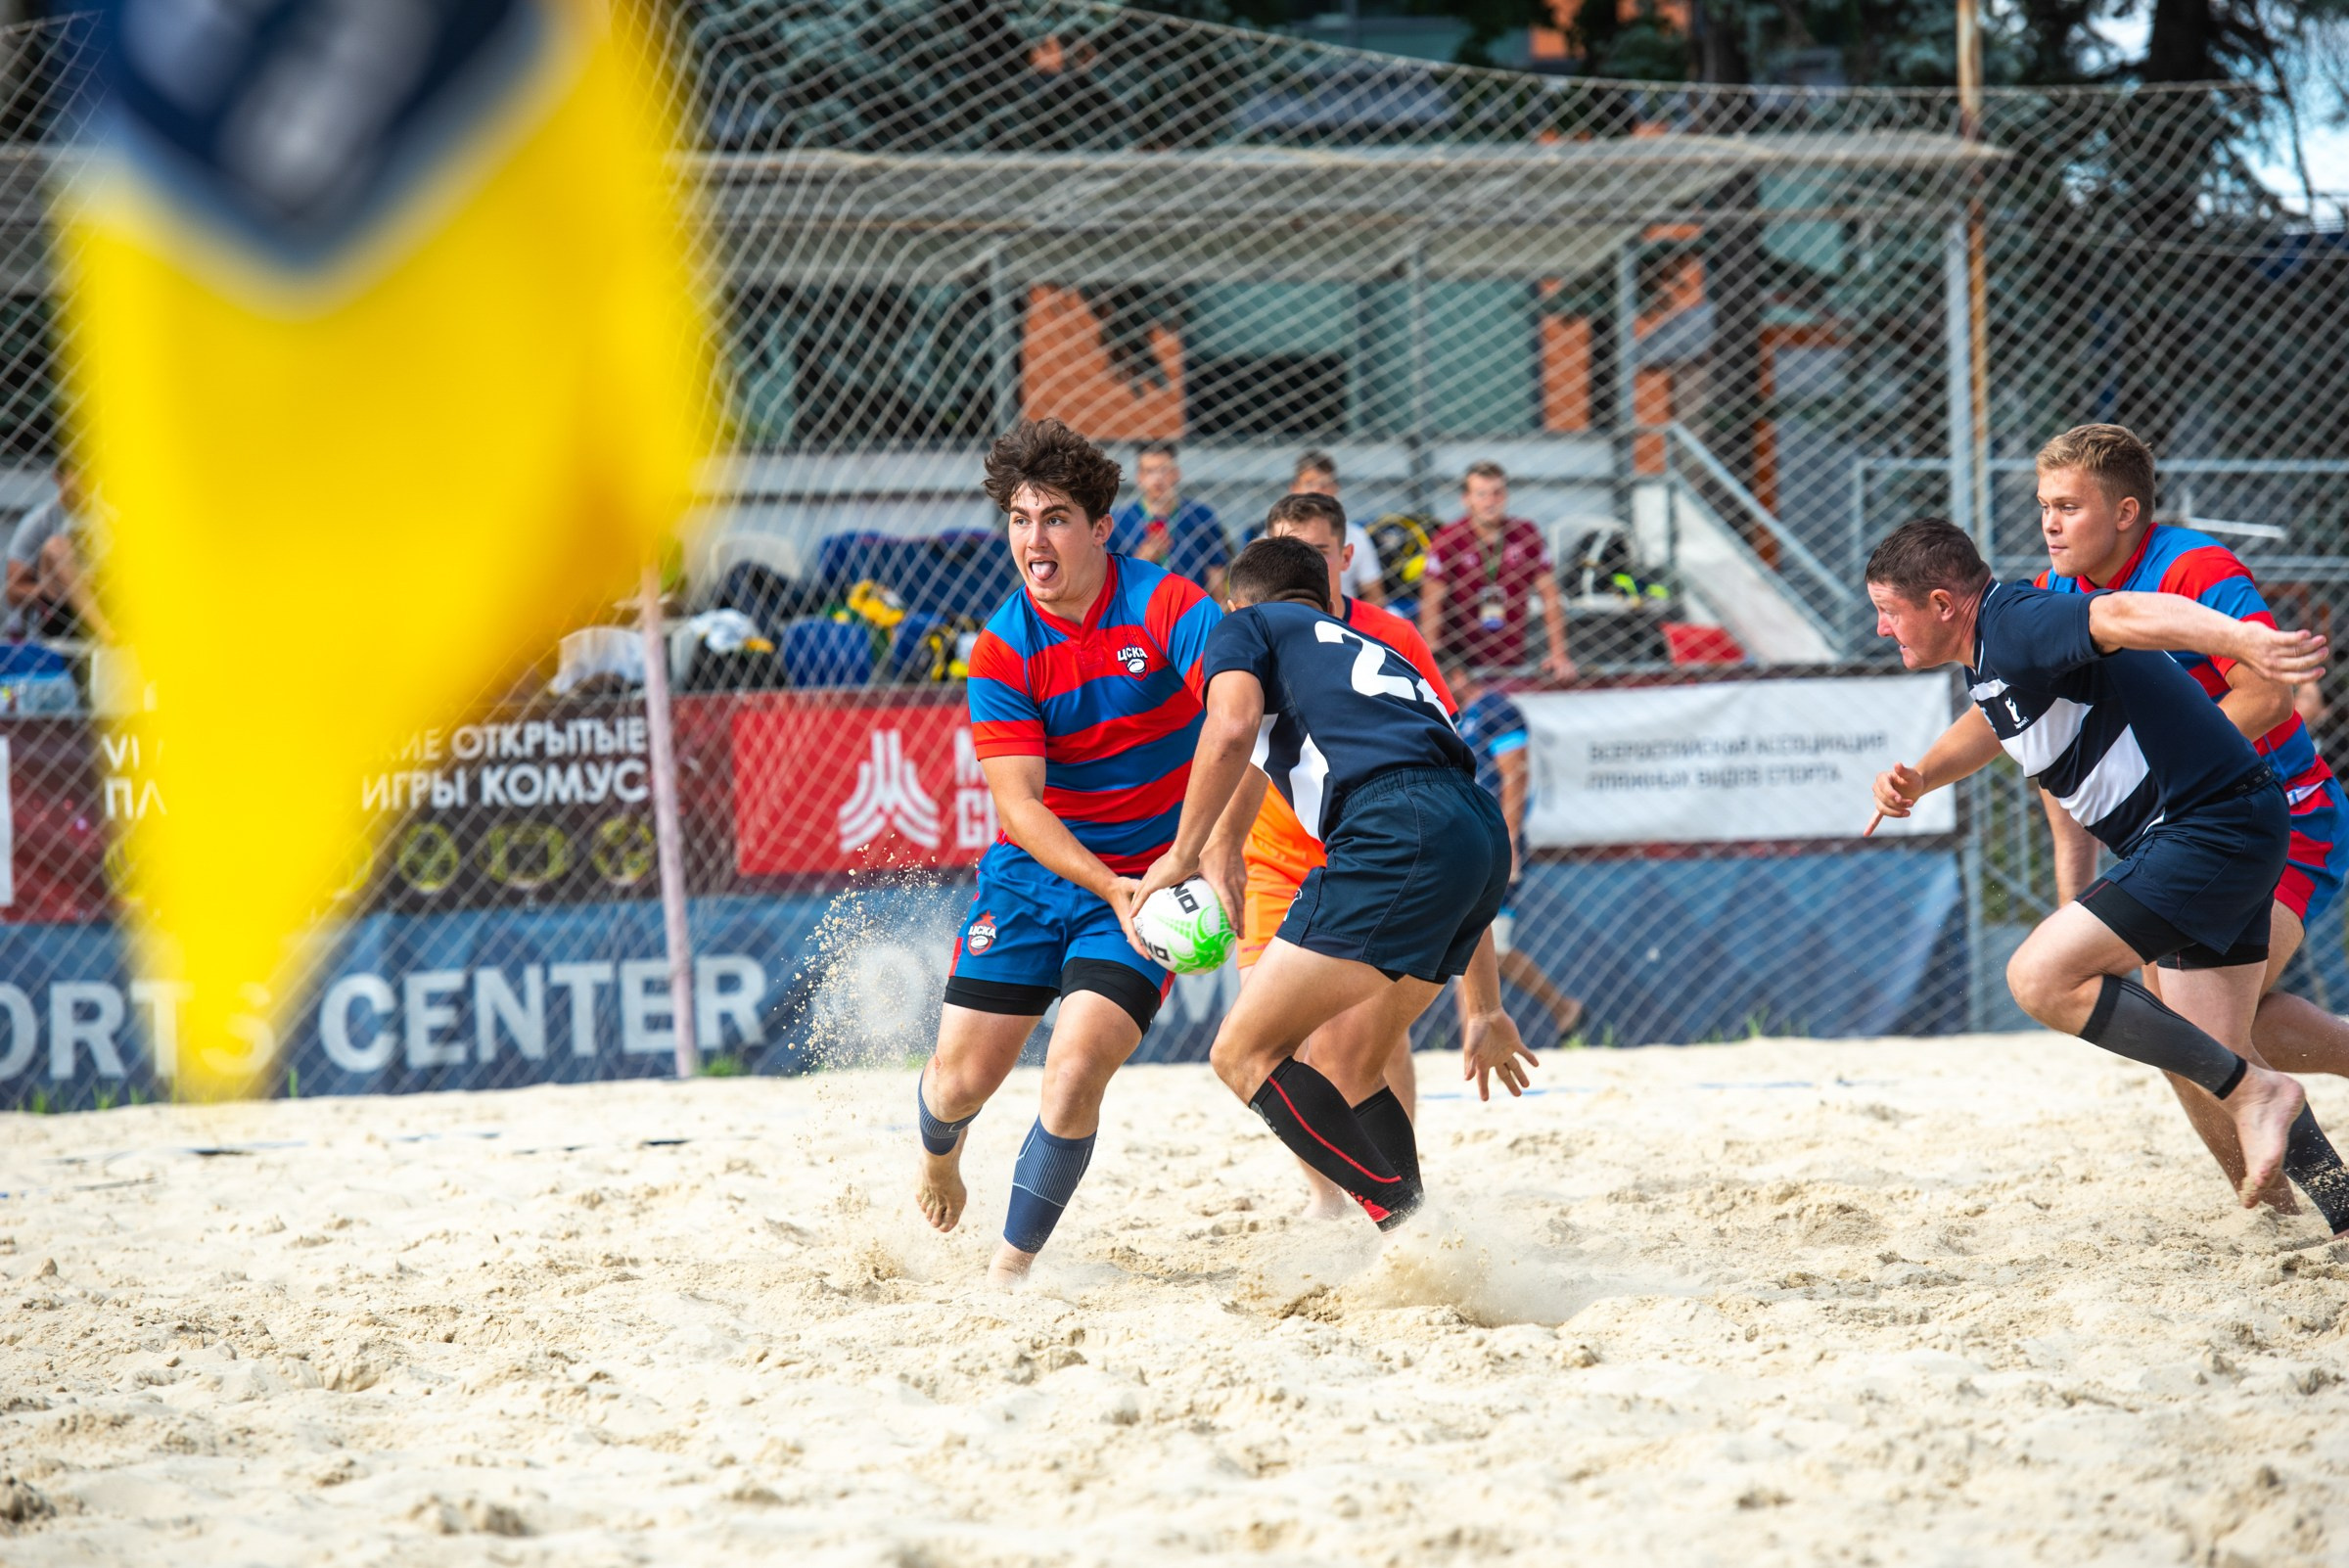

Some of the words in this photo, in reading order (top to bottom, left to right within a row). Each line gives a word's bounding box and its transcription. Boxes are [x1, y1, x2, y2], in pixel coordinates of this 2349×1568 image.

[1117, 647, 1148, 662] ЦСКА
[451, 715, 647, 760] ОТКРЫТЫЕ
[362, 768, 468, 811] ИГРЫ
[482, 759, 649, 807] КОМУС
[968, 925, 996, 939] ЦСКА
[318, 953, 766, 1074] CENTER
